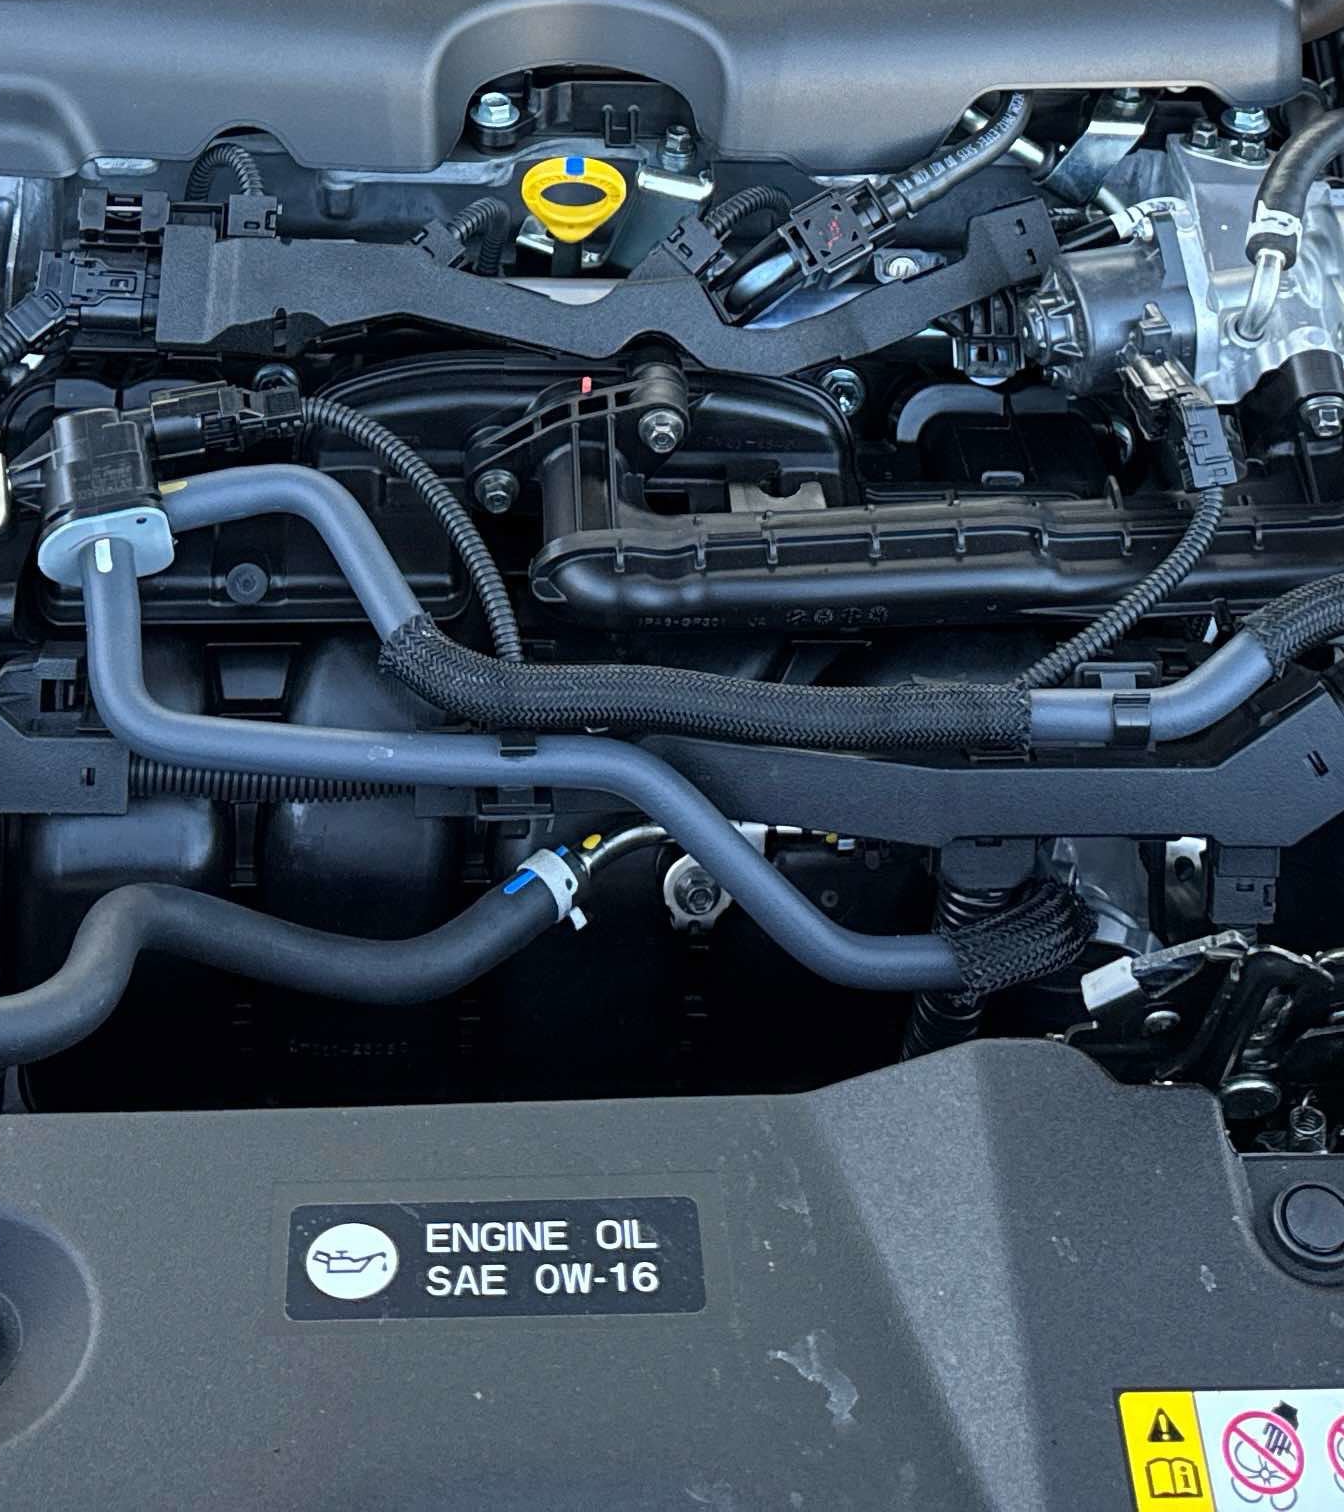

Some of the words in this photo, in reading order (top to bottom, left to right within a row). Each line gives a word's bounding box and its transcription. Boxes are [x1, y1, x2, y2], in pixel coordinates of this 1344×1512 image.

[425, 1220, 569, 1253] ENGINE
[595, 1219, 659, 1250] OIL
[426, 1265, 507, 1296] SAE
[534, 1261, 659, 1294] 0W-16
